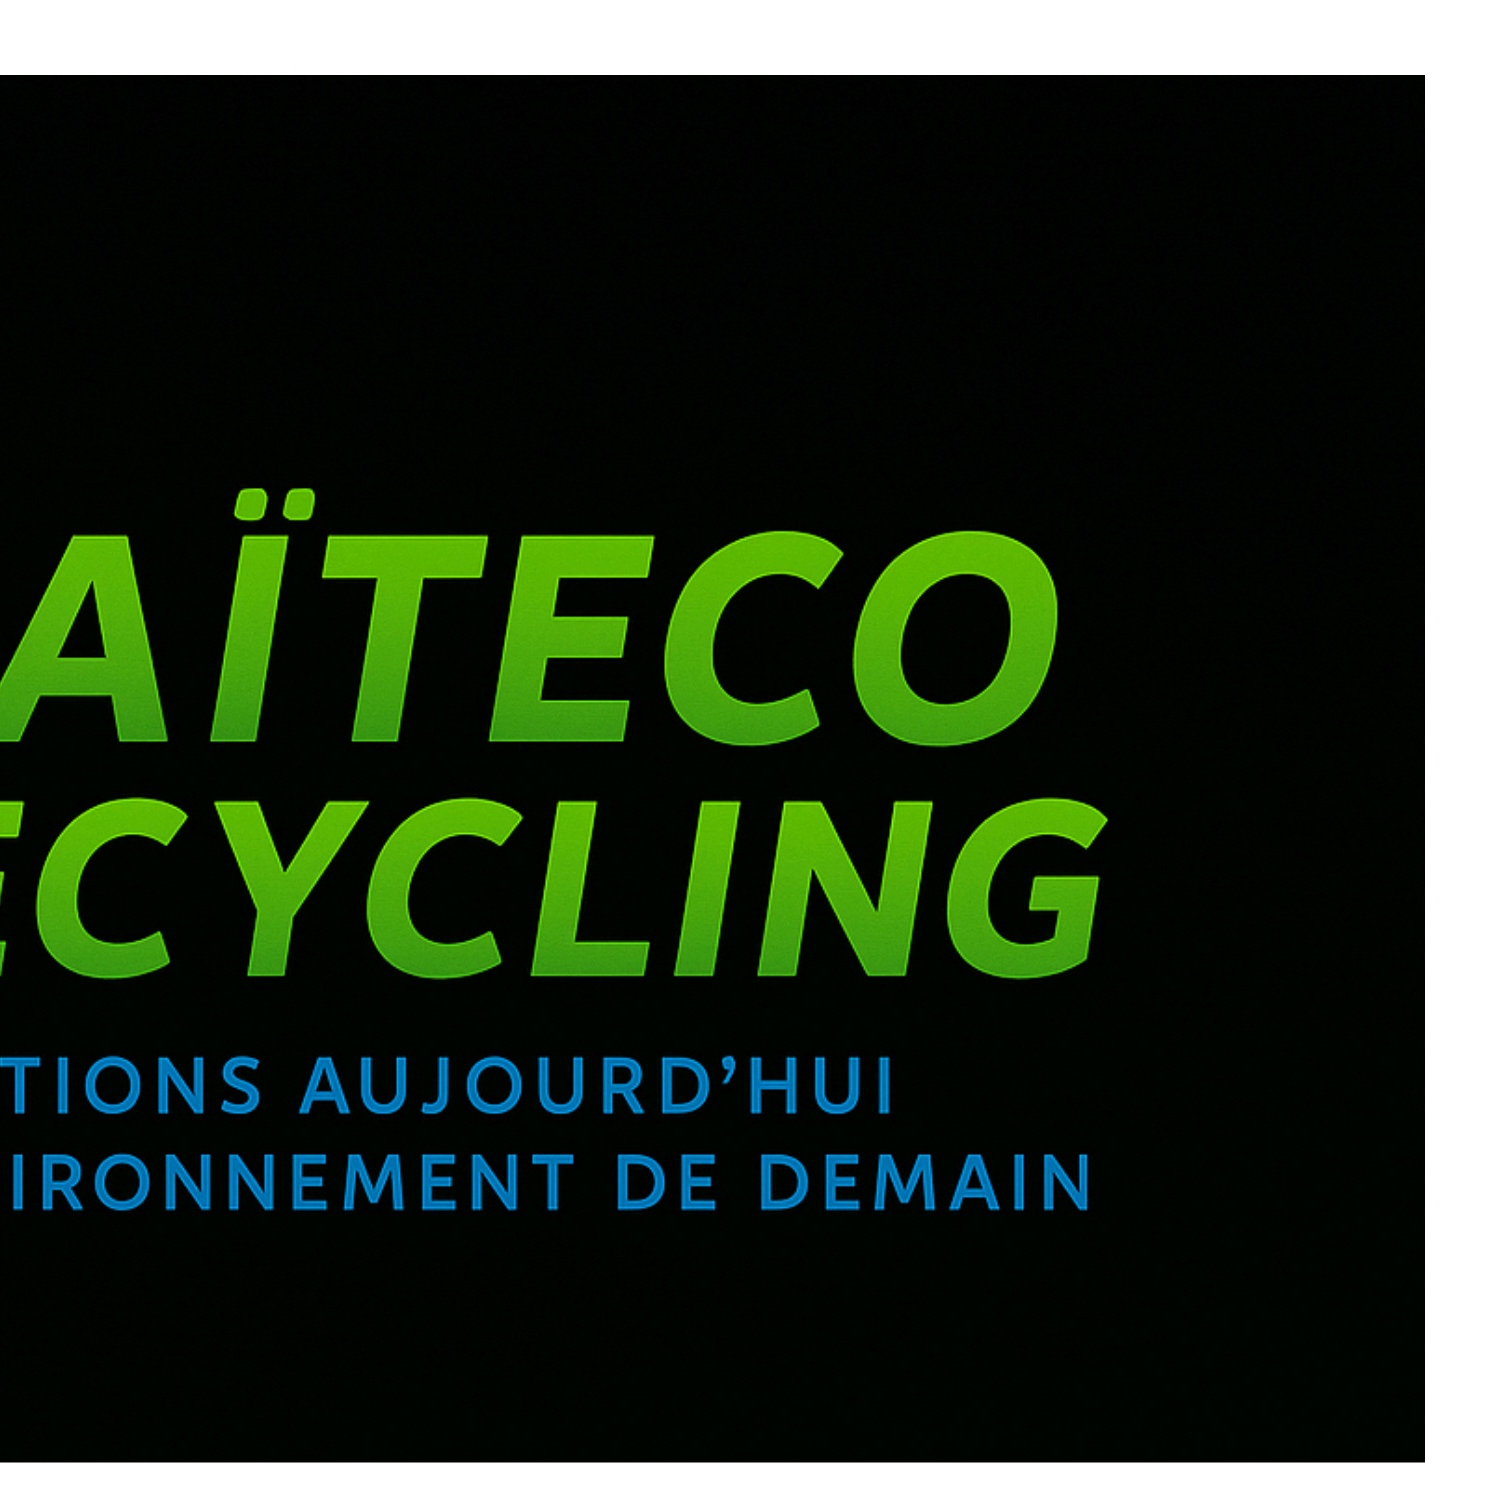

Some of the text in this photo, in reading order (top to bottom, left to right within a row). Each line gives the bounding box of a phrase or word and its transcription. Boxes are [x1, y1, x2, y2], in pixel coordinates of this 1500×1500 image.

[298, 1056, 893, 1116] AUJOURD’HUI
[616, 1153, 716, 1212] DE
[759, 1153, 1090, 1212] DEMAIN
